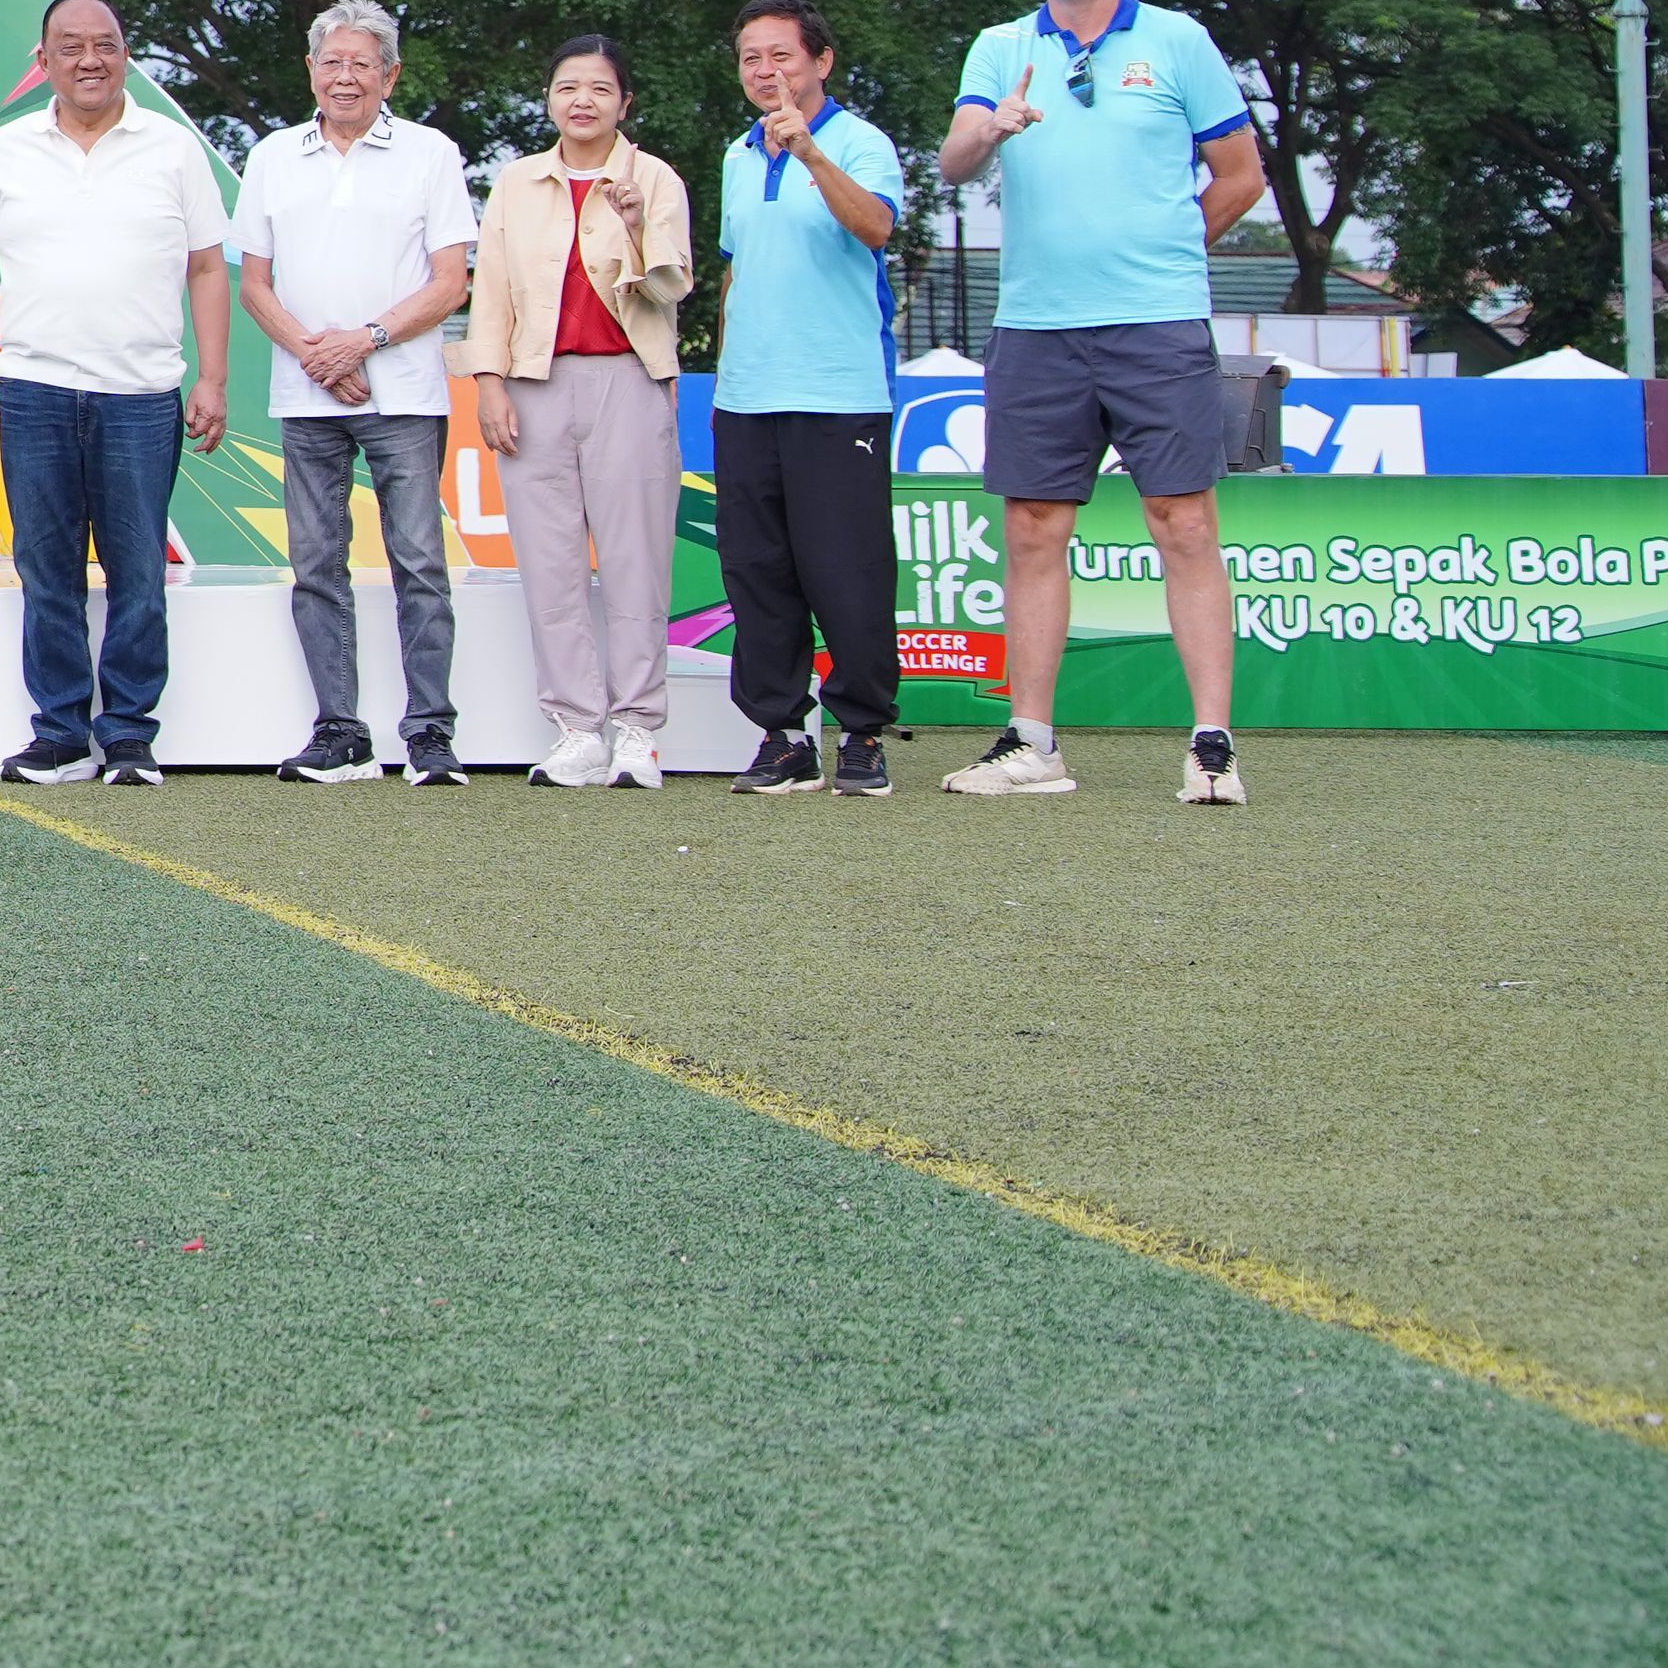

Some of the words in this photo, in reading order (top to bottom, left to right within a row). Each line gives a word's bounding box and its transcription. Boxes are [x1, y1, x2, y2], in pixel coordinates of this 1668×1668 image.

[1327, 534, 1498, 594] Sepak
[1508, 534, 1631, 585] Bola
[895, 563, 1005, 626] ife
[1235, 595, 1310, 653] KU
[1321, 604, 1377, 641] 10
[1390, 594, 1431, 645] &
[1440, 596, 1516, 655] KU
[1528, 604, 1583, 643] 12
[897, 633, 967, 651] OCCER
[898, 653, 987, 672] ALLENGE
